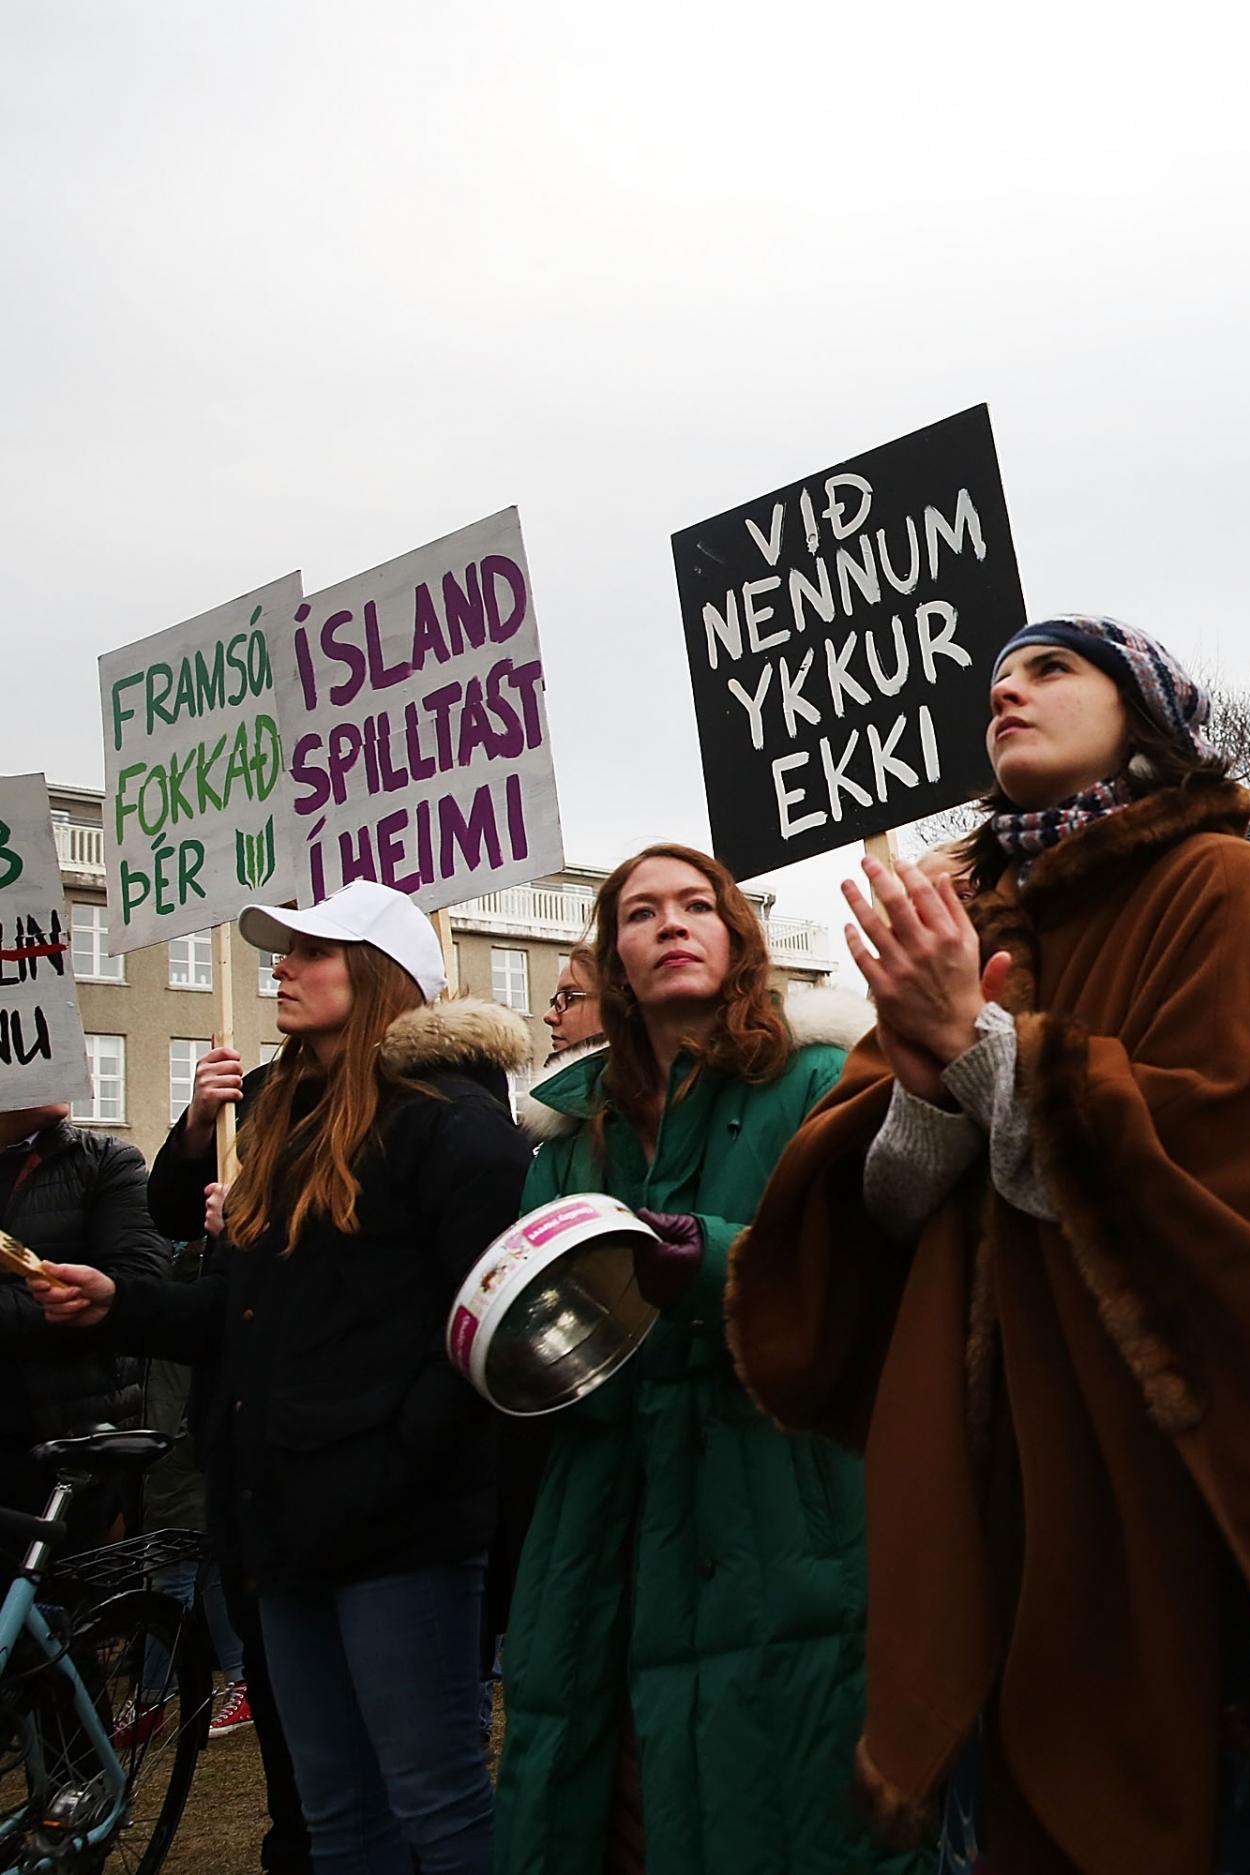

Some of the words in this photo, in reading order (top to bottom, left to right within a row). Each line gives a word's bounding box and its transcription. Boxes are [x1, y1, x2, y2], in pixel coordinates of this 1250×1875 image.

[702, 488, 987, 670] NENNUM
[745, 473, 873, 567] VIÐ
[294, 555, 527, 711] ÍSLAND
[728, 600, 973, 750] YKKUR
[115, 714, 280, 845] FOKKAÐ
[290, 658, 543, 815] SPILLTAST
[772, 705, 942, 840] EKKI
[121, 832, 207, 925] ÞÉR
[338, 773, 528, 895] HEIMI
